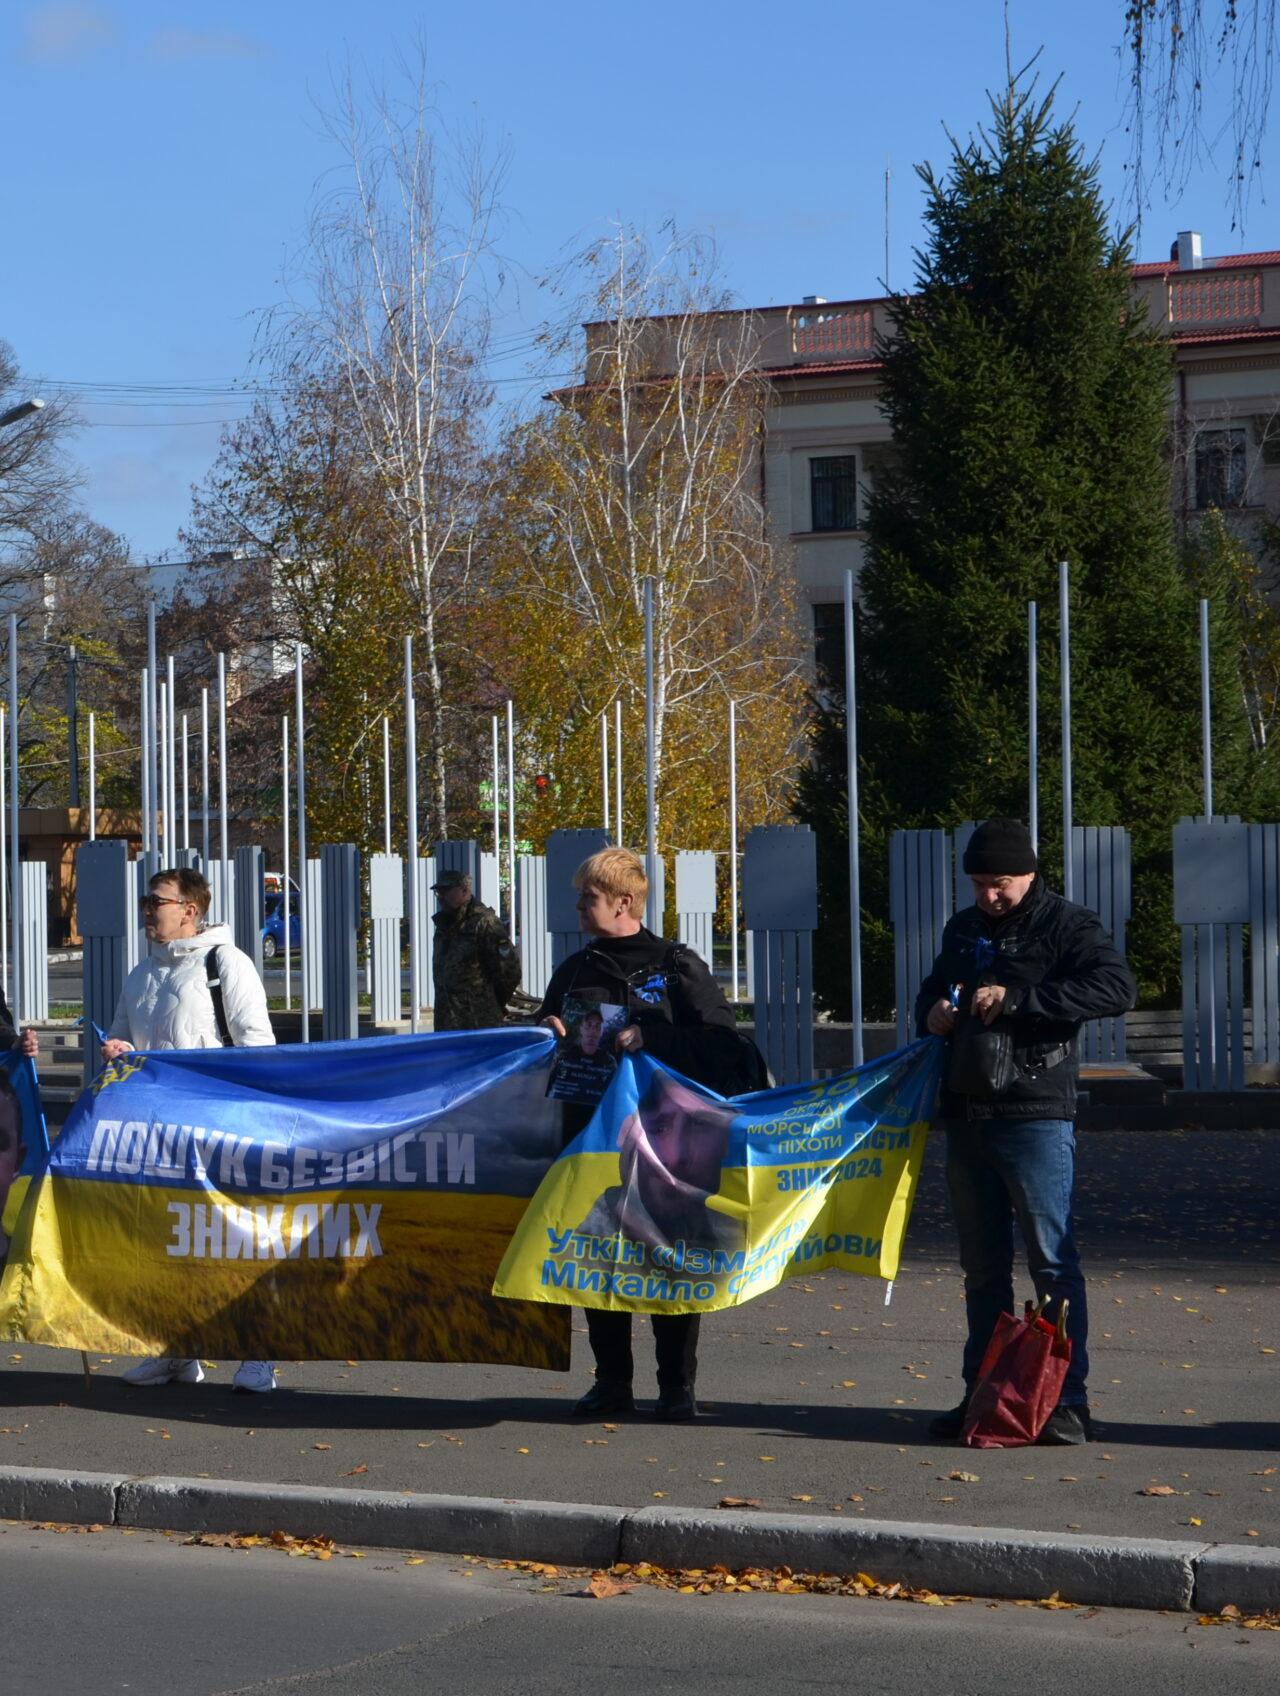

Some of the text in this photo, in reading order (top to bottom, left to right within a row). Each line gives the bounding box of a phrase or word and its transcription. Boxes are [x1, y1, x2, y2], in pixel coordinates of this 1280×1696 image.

[747, 1115, 843, 1137] МОРСЬКОЇ
[778, 1135, 843, 1154] ПІХОТИ
[86, 1119, 476, 1190] ПОШУК БЕЗВІСТИ
[166, 1201, 384, 1260] ЗНИКЛИХ
[546, 1226, 646, 1266] Уткін
[541, 1259, 717, 1302] Михайло
